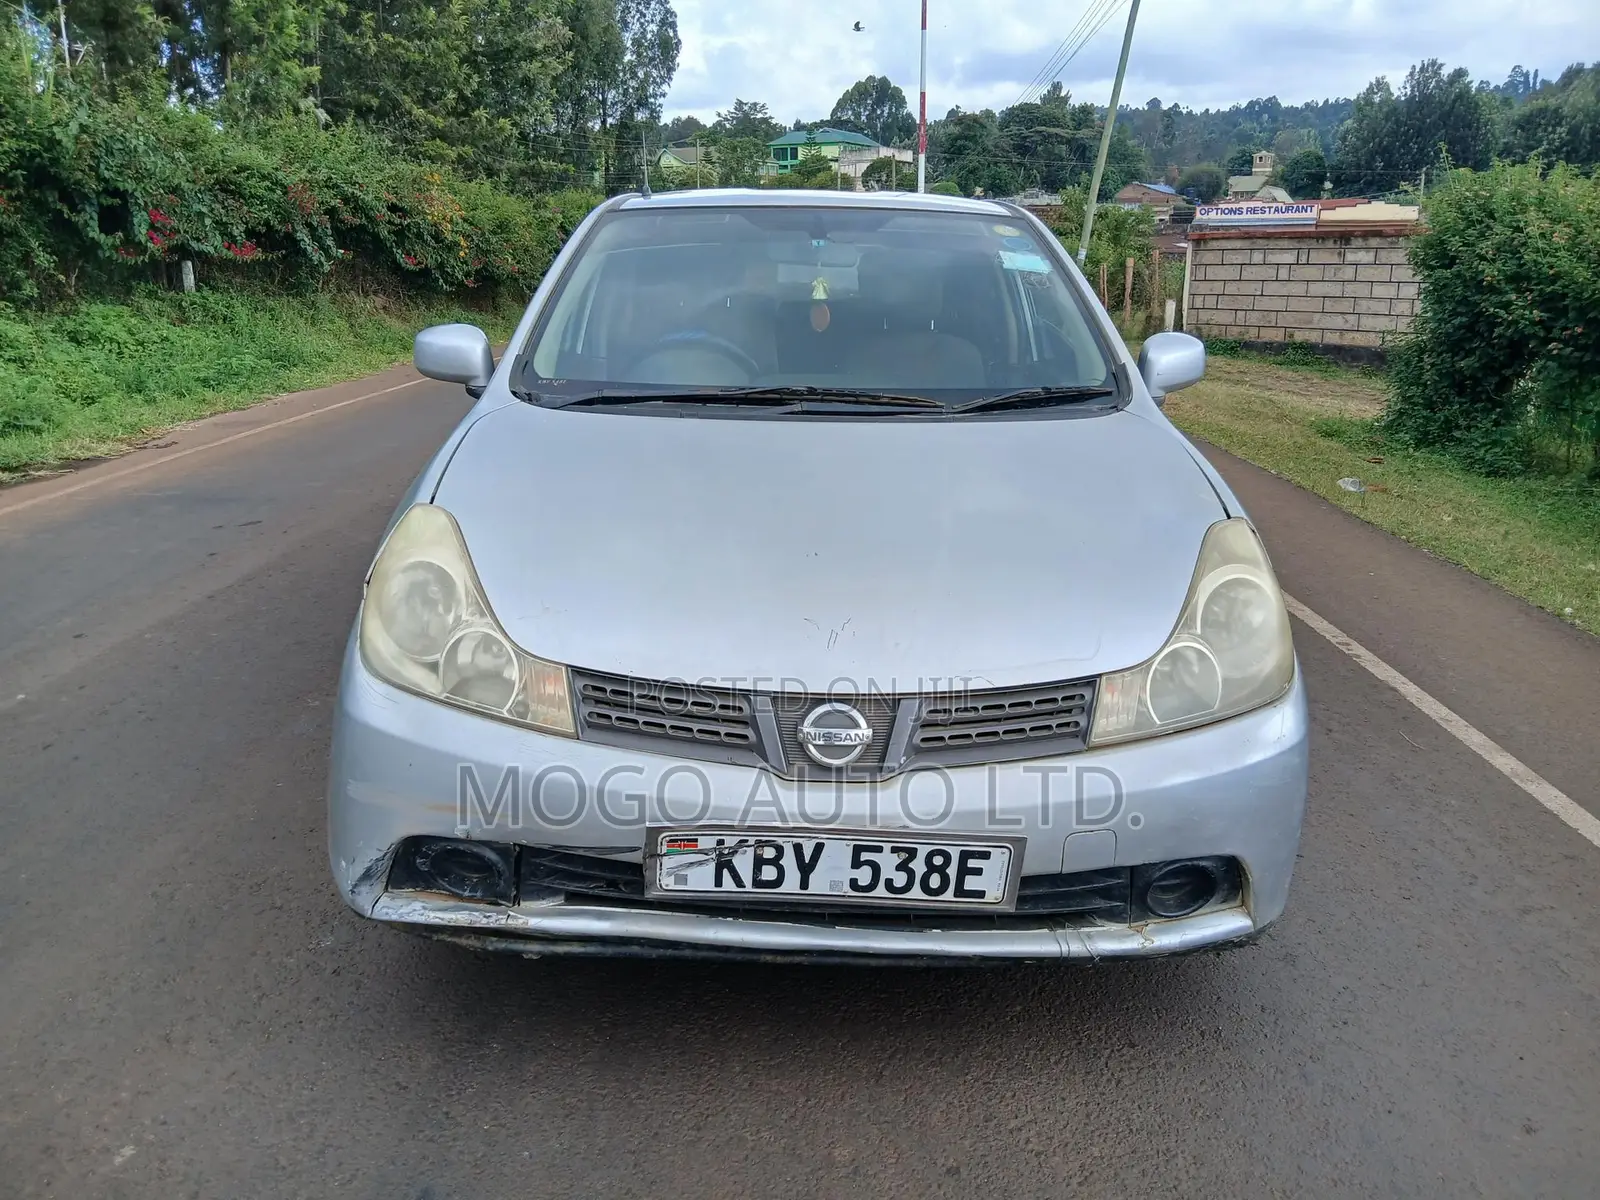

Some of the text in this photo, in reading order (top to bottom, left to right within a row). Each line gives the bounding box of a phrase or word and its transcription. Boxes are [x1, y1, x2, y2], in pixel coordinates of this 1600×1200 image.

[1199, 205, 1315, 216] OPTIONS RESTAURANT
[805, 731, 865, 743] NISSAN
[714, 838, 826, 891] KBY
[849, 843, 992, 899] 538E
